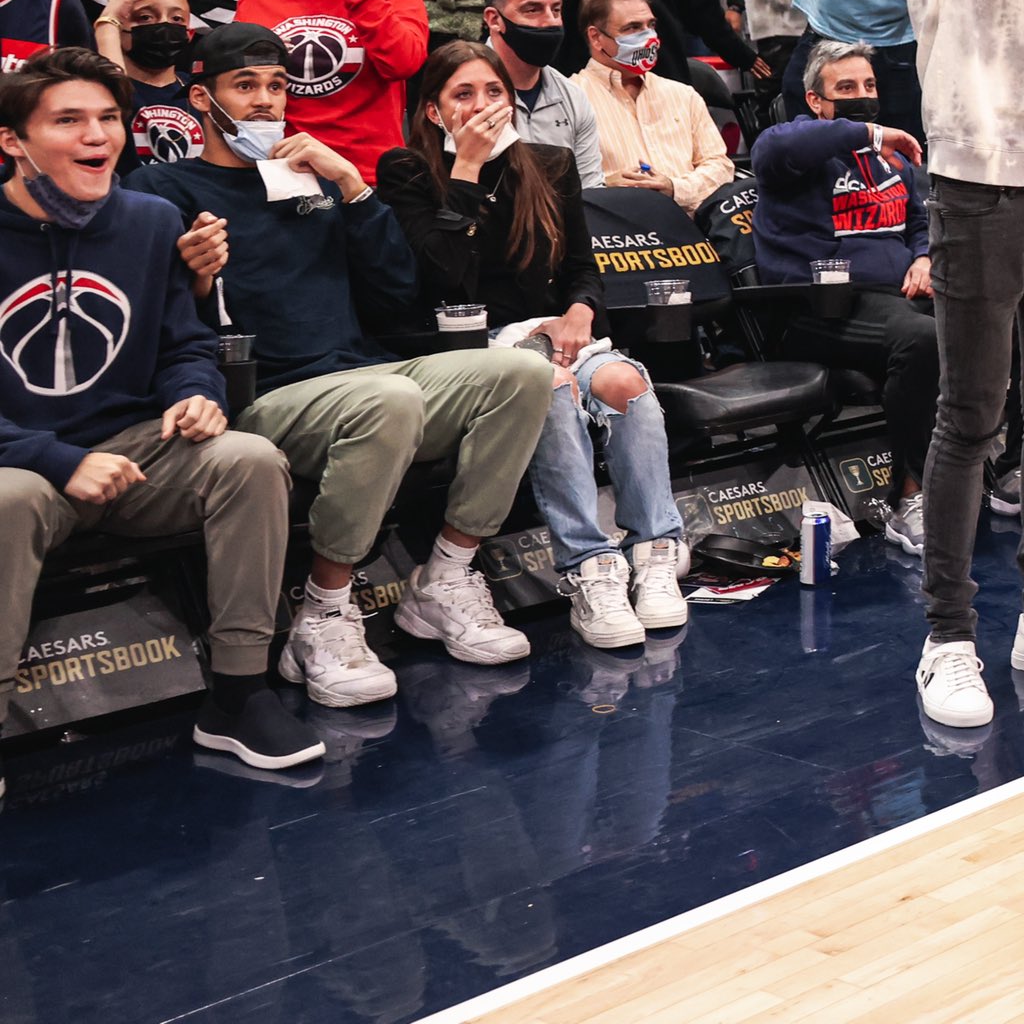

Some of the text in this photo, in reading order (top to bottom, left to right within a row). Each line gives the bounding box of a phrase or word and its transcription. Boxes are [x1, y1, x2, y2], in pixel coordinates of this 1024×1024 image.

[274, 17, 353, 36] WASHINGTON
[286, 76, 343, 96] IZARDS
[708, 480, 766, 503] CAESARS
[713, 486, 810, 525] SPORTSBOOK
[15, 635, 182, 694] SPORTSBOOK
